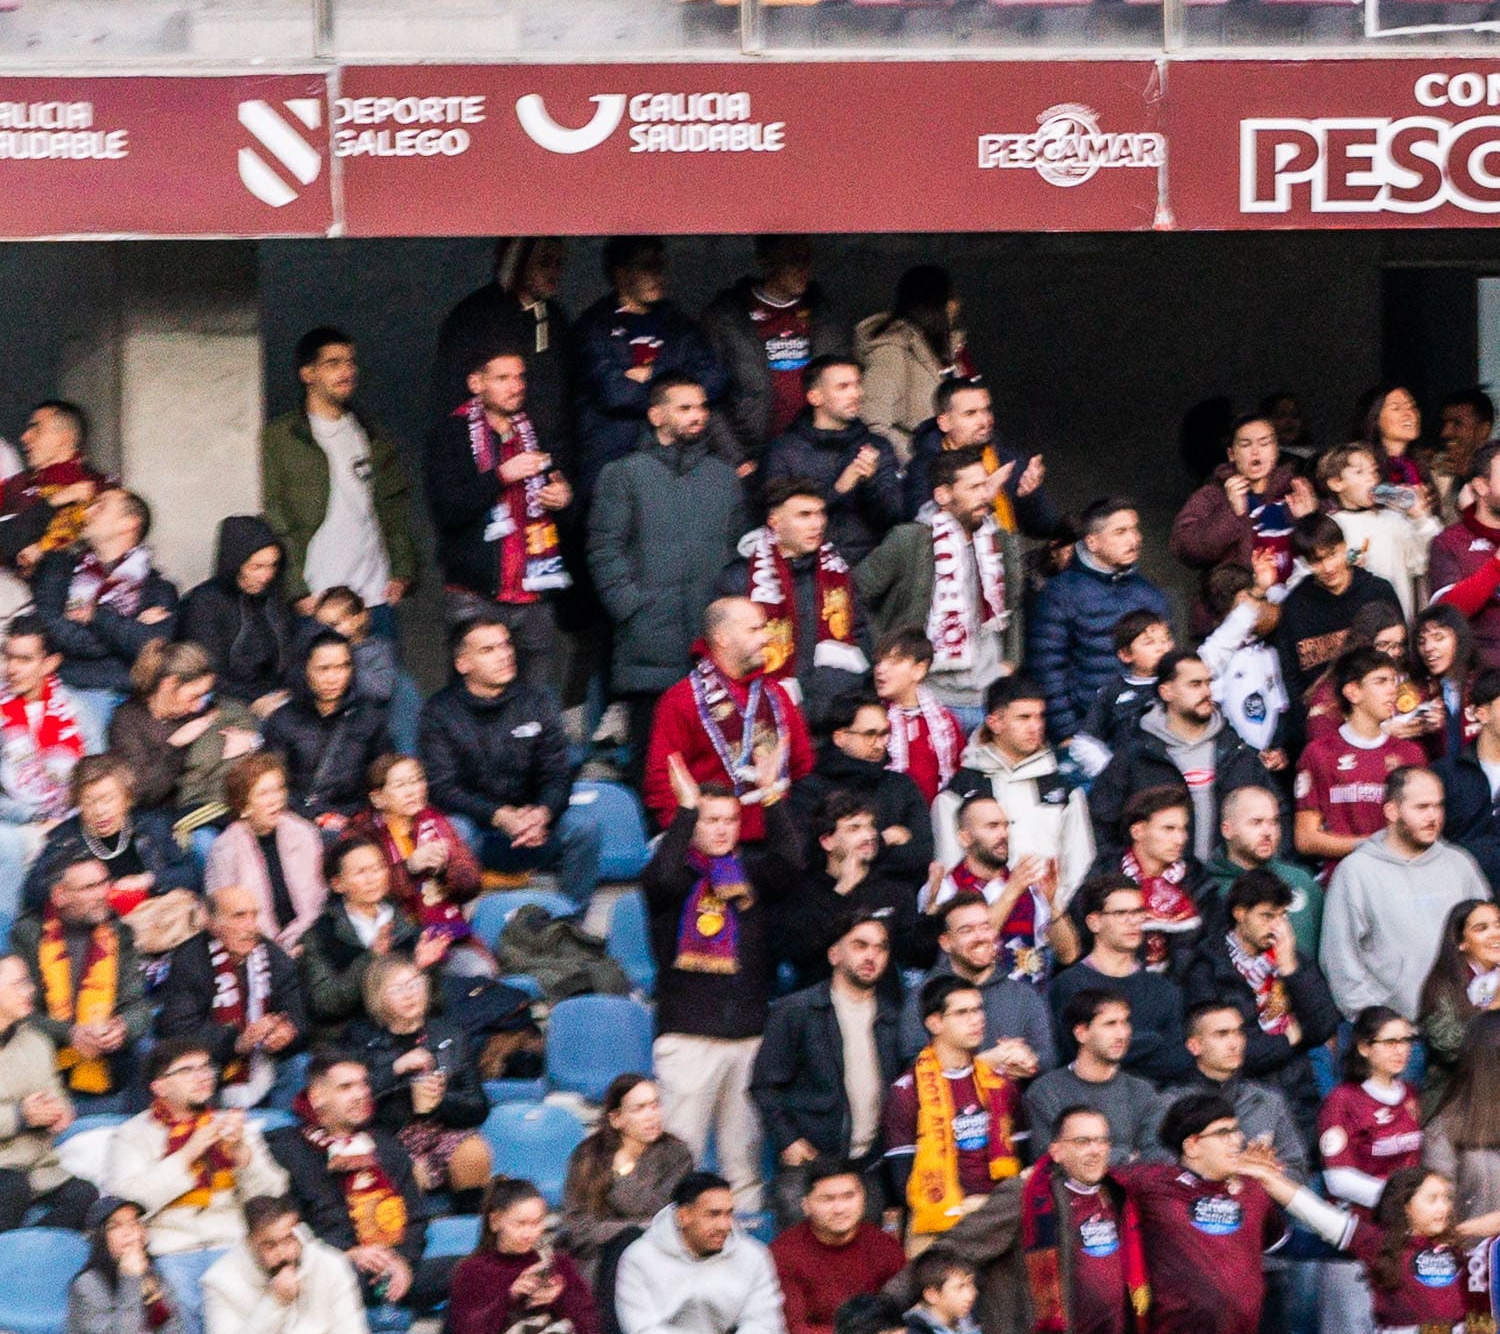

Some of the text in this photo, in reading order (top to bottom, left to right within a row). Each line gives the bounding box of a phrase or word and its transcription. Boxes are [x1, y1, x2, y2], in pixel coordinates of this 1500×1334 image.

[0, 101, 94, 130] ALICIA
[334, 95, 487, 126] DEPORTE
[628, 91, 751, 124] GALICIA
[0, 129, 130, 160] AUDABLE
[334, 127, 471, 158] GALEGO
[628, 121, 786, 154] SAUDABLE
[978, 133, 1166, 169] PESCAMAR
